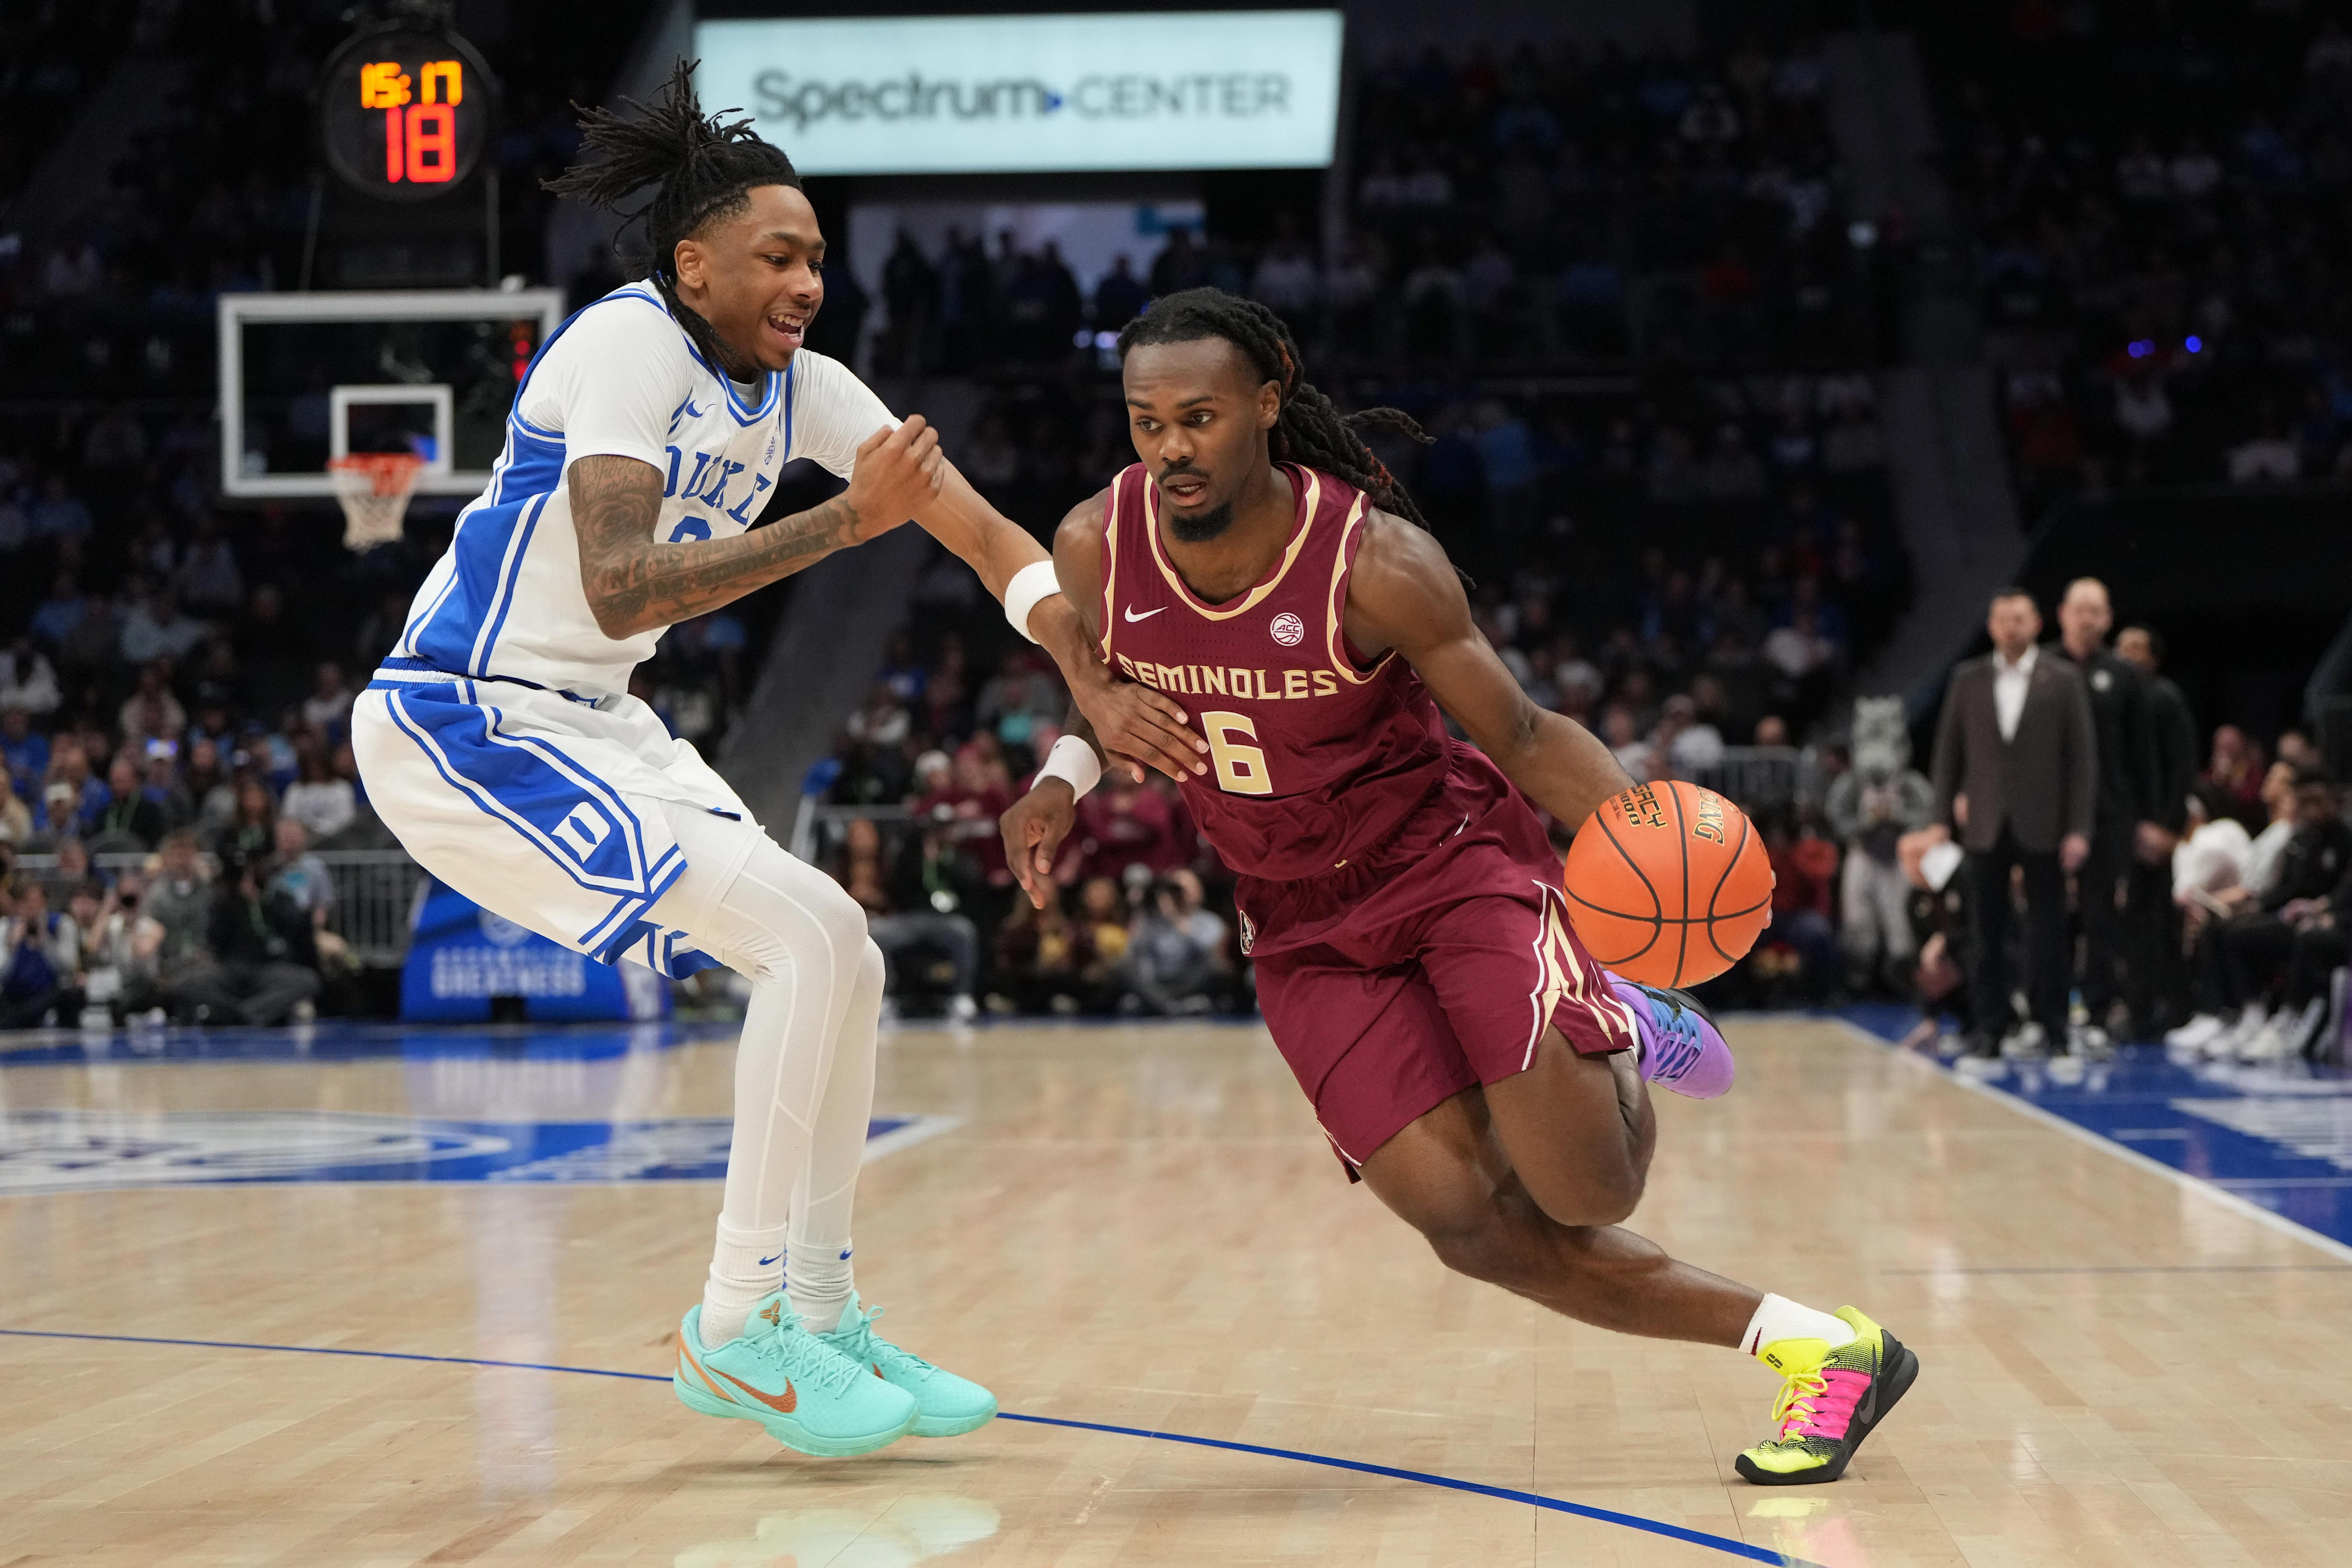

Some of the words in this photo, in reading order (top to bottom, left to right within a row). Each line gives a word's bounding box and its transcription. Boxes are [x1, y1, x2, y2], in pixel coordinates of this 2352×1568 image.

[753, 68, 1048, 132] Spectrum
[1071, 73, 1293, 117] CENTER
[386, 103, 455, 183] 18
[1116, 652, 1339, 700] SEMINOLES
[1200, 710, 1273, 794] 6
[551, 801, 611, 864] D
[1631, 784, 1668, 830] GACY
